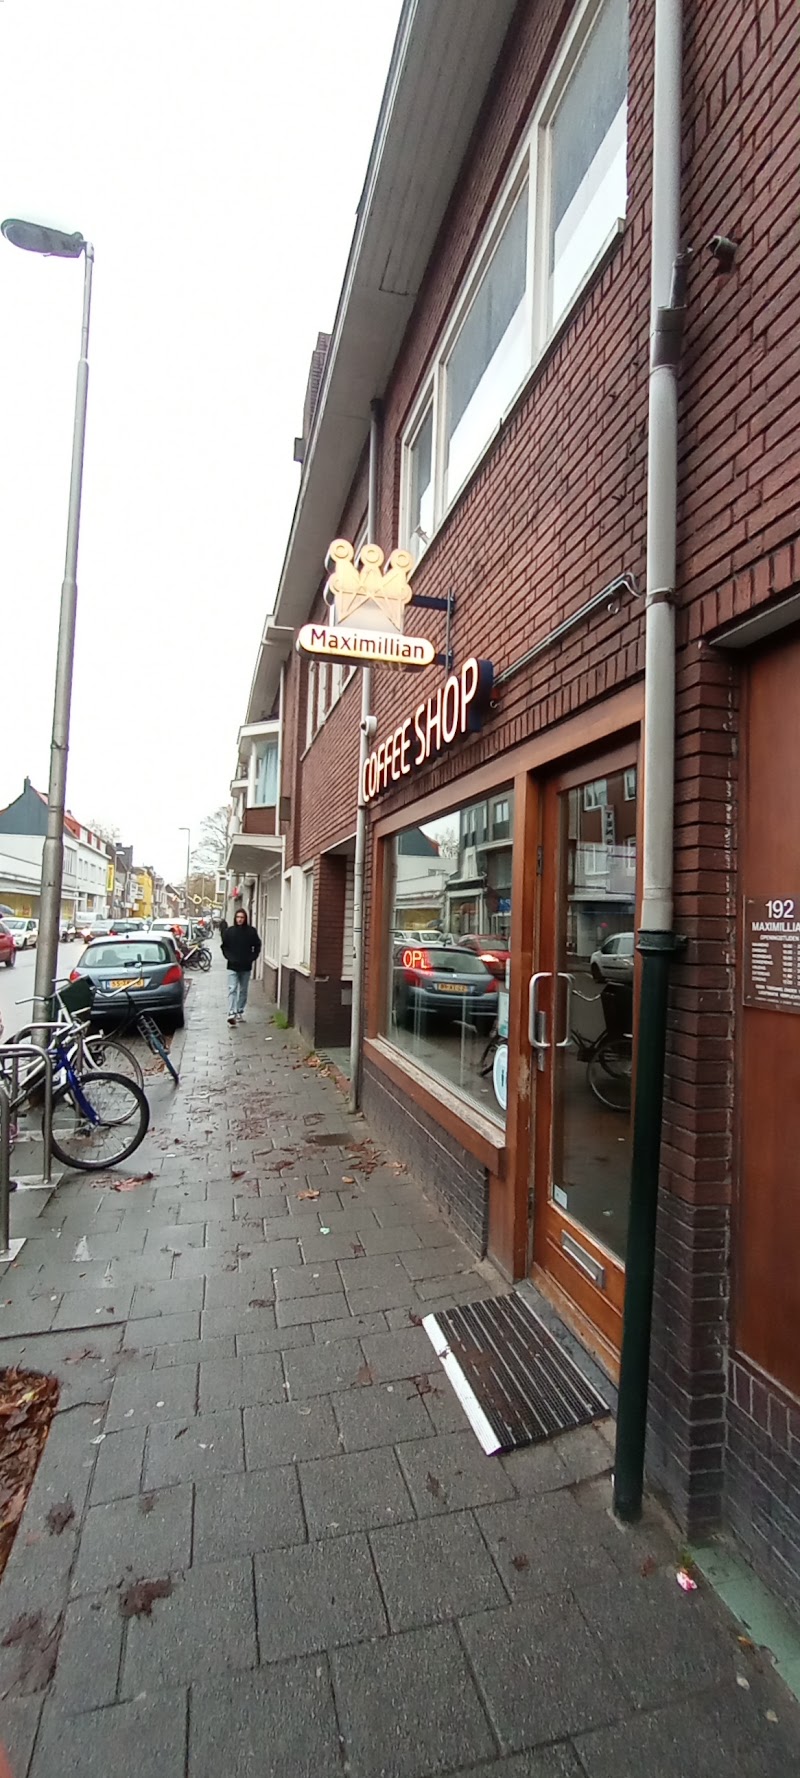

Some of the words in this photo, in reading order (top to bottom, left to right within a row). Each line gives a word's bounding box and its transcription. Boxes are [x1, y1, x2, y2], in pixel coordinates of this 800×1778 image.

[310, 628, 424, 659] Maximillian
[362, 717, 412, 803] COFFEE
[414, 657, 478, 765] SHOP
[765, 900, 794, 918] 192
